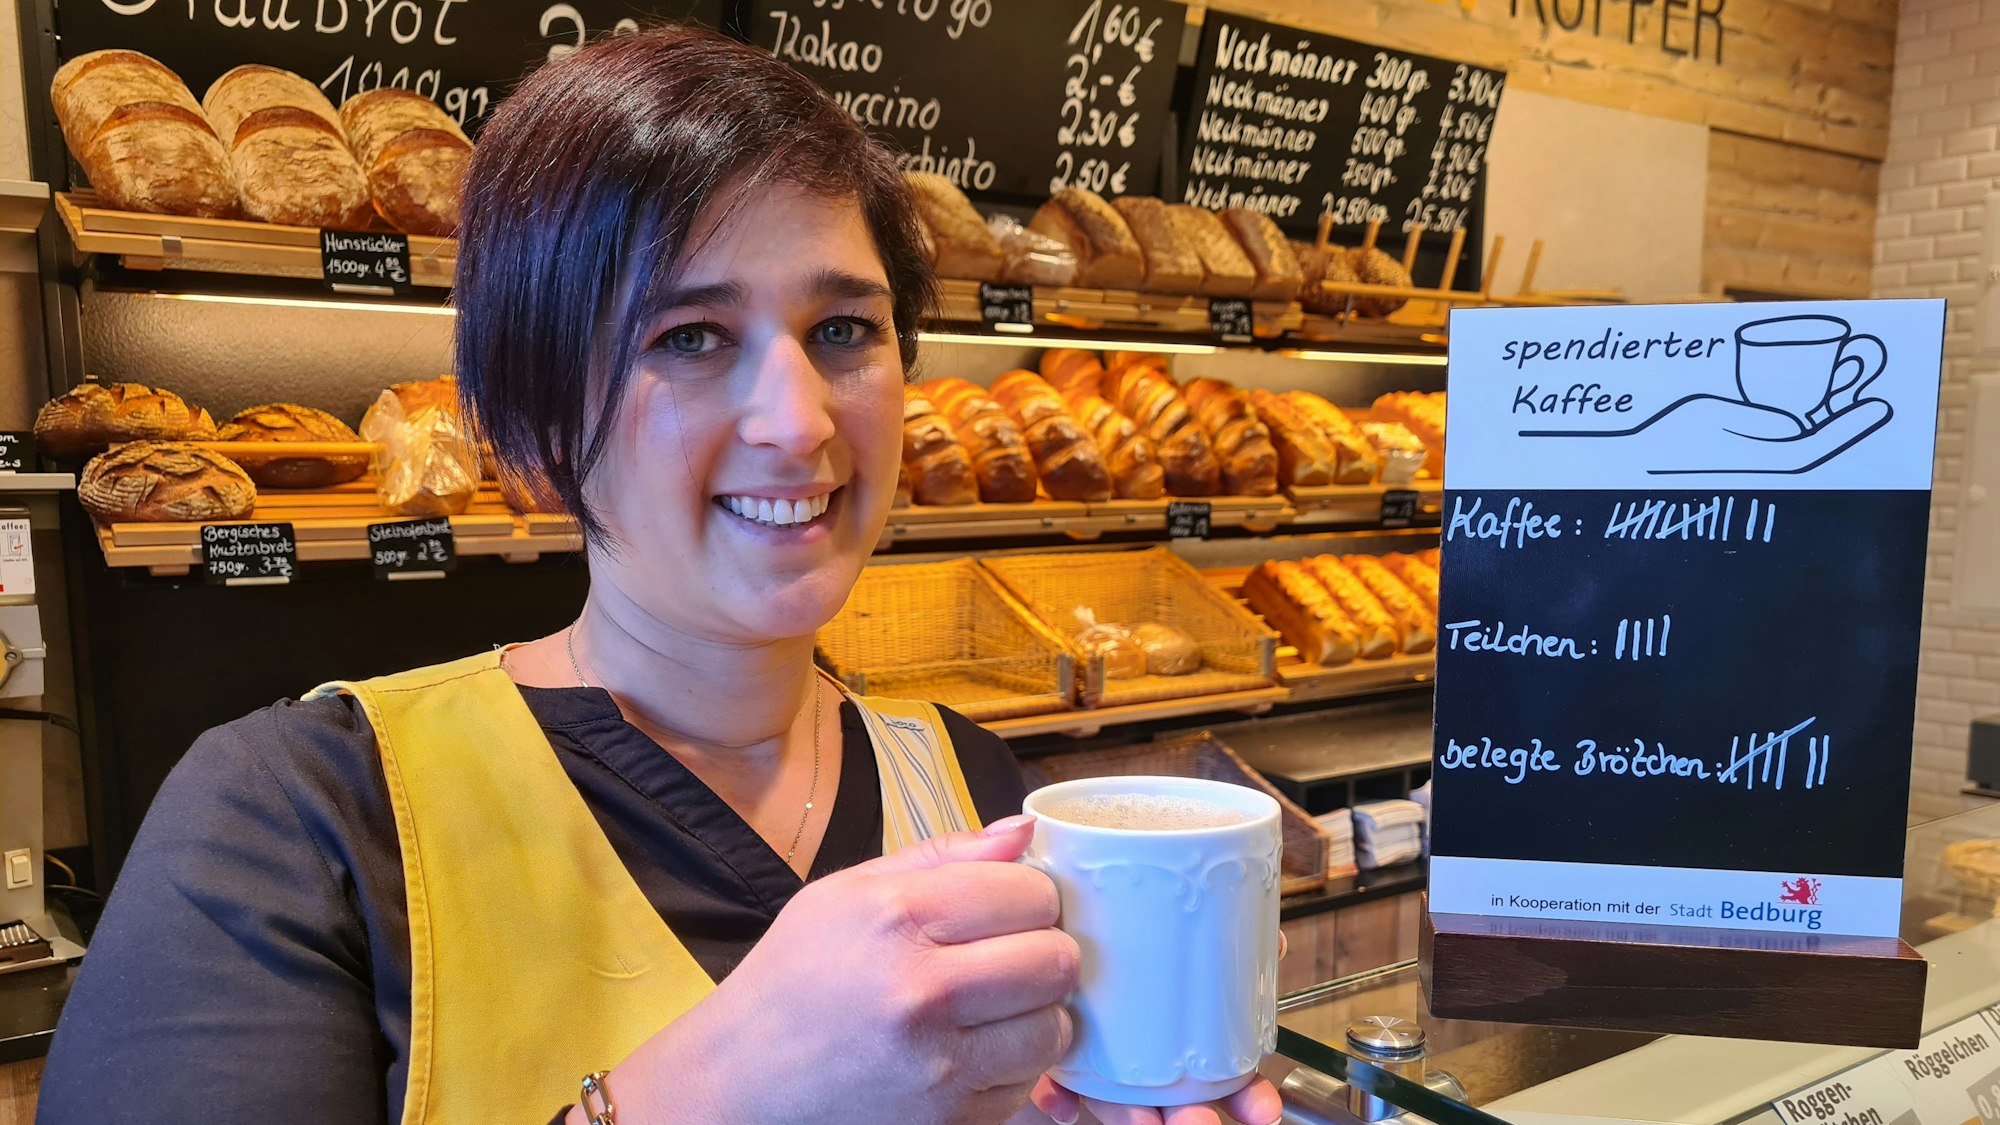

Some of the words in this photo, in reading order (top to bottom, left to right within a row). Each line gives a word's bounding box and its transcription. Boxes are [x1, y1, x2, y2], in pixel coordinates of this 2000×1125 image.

[325, 232, 405, 253] Hunsrücker
[1502, 327, 1725, 369] spendierter
[1512, 383, 1633, 414] Kaffee
[203, 524, 281, 543] Bergisches
[209, 538, 294, 558] Krustenbrot
[1445, 619, 1598, 660] Teilchen:
[1440, 737, 1561, 784] belegte
[1491, 895, 1504, 907] in
[1509, 895, 1601, 913] Kooperation
[1606, 901, 1630, 914] mit
[1635, 902, 1661, 915] der
[1669, 903, 1713, 918] Stadt
[1720, 900, 1823, 930] Bedburg
[1903, 1032, 1990, 1081] Röggelchen
[1782, 1081, 1853, 1123] Roggen-
